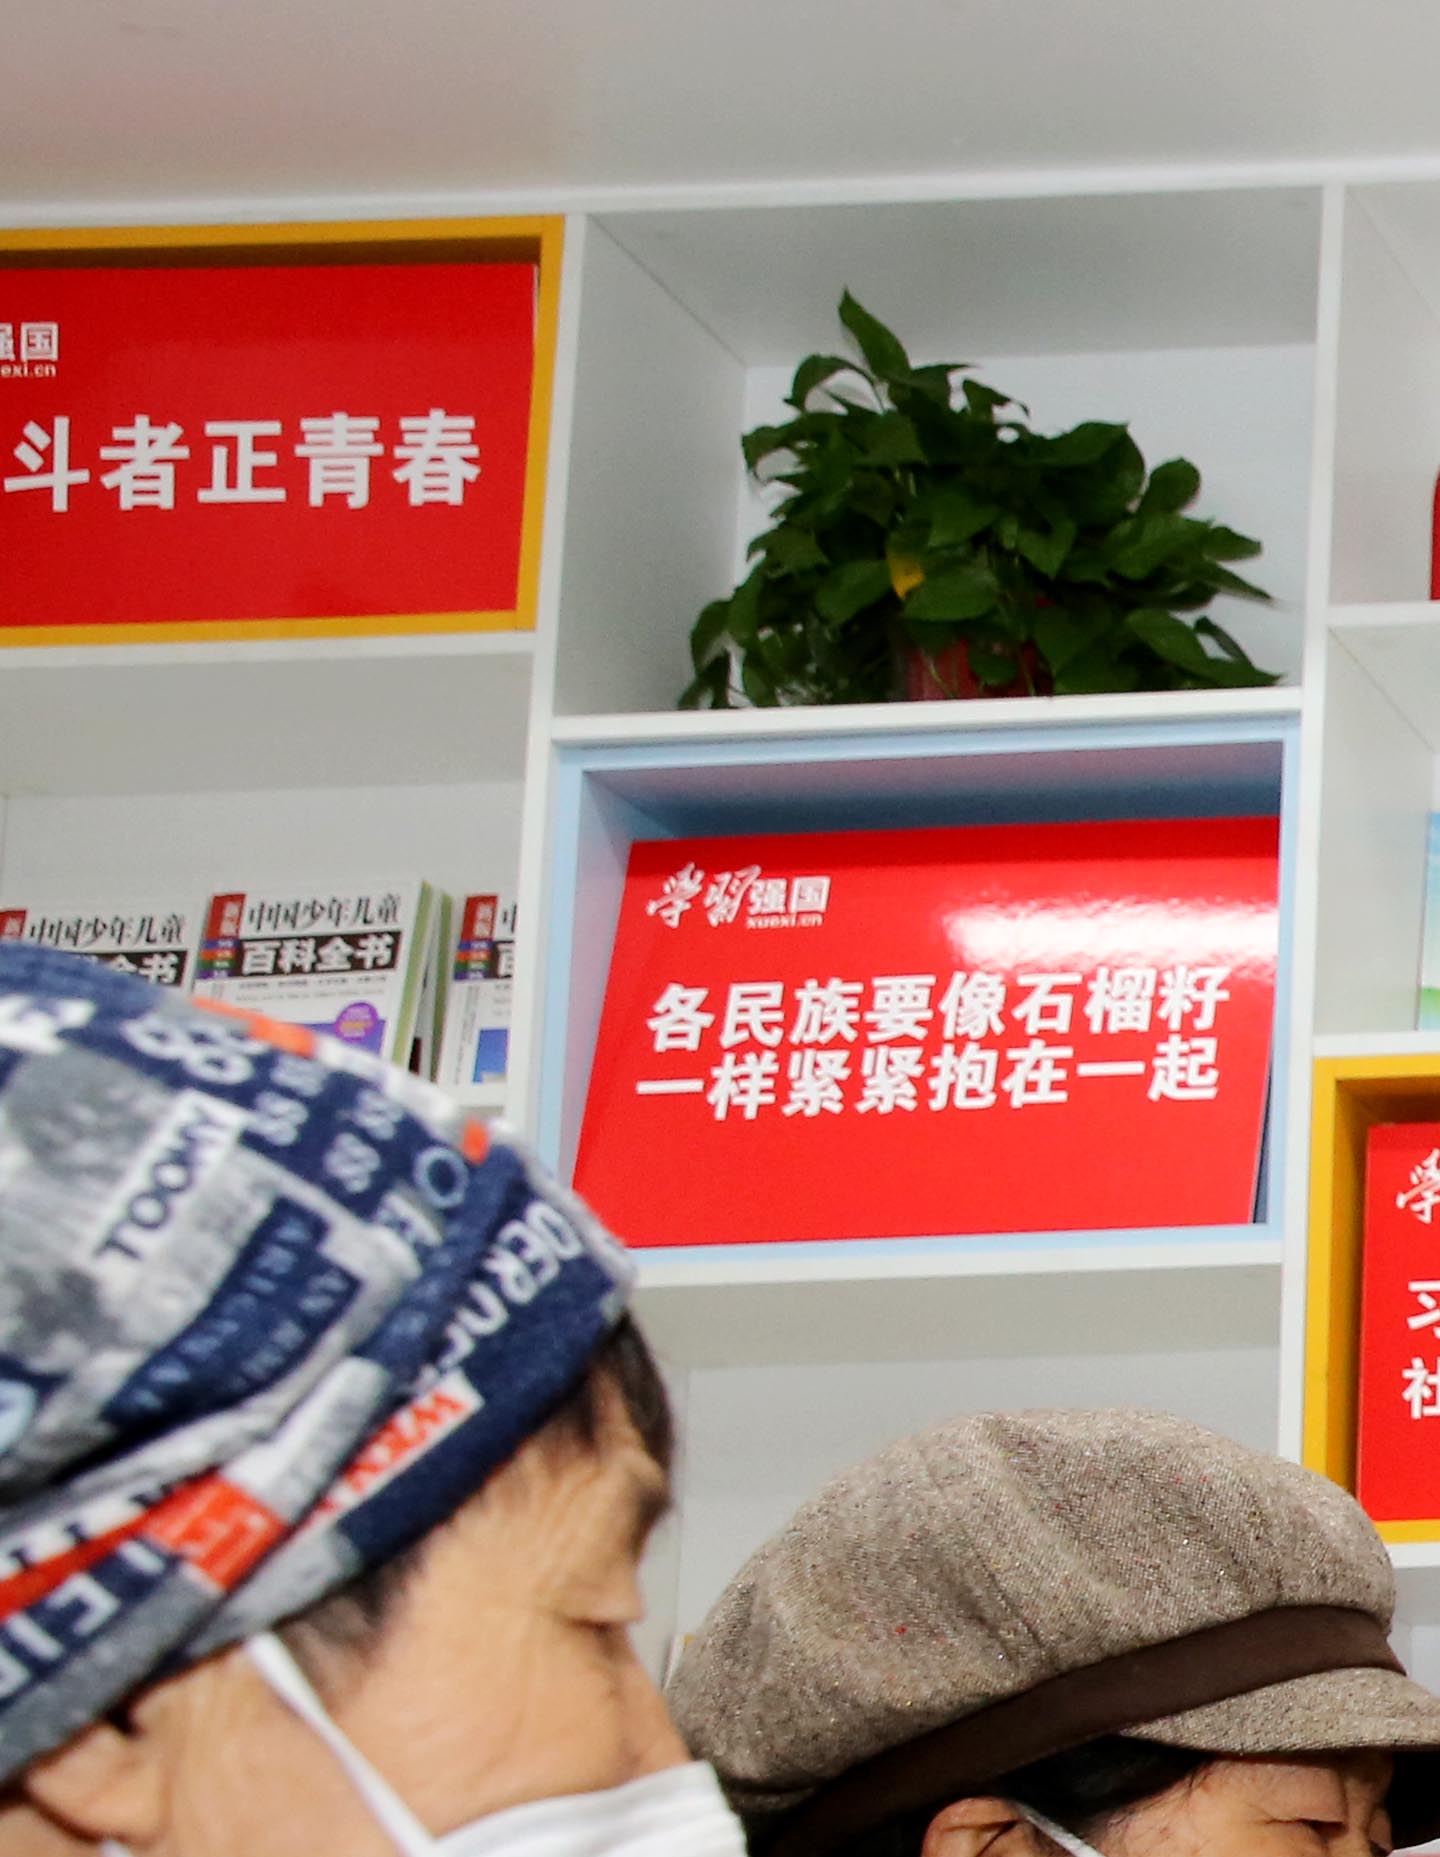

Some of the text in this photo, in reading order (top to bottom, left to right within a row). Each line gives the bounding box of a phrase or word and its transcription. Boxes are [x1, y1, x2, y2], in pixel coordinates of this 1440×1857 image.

[3, 408, 481, 512] 斗者正青春
[242, 932, 394, 975] 百科全书
[646, 966, 1230, 1052] 各民族要像石榴籽
[636, 1035, 1219, 1121] 一样紧紧抱在一起
